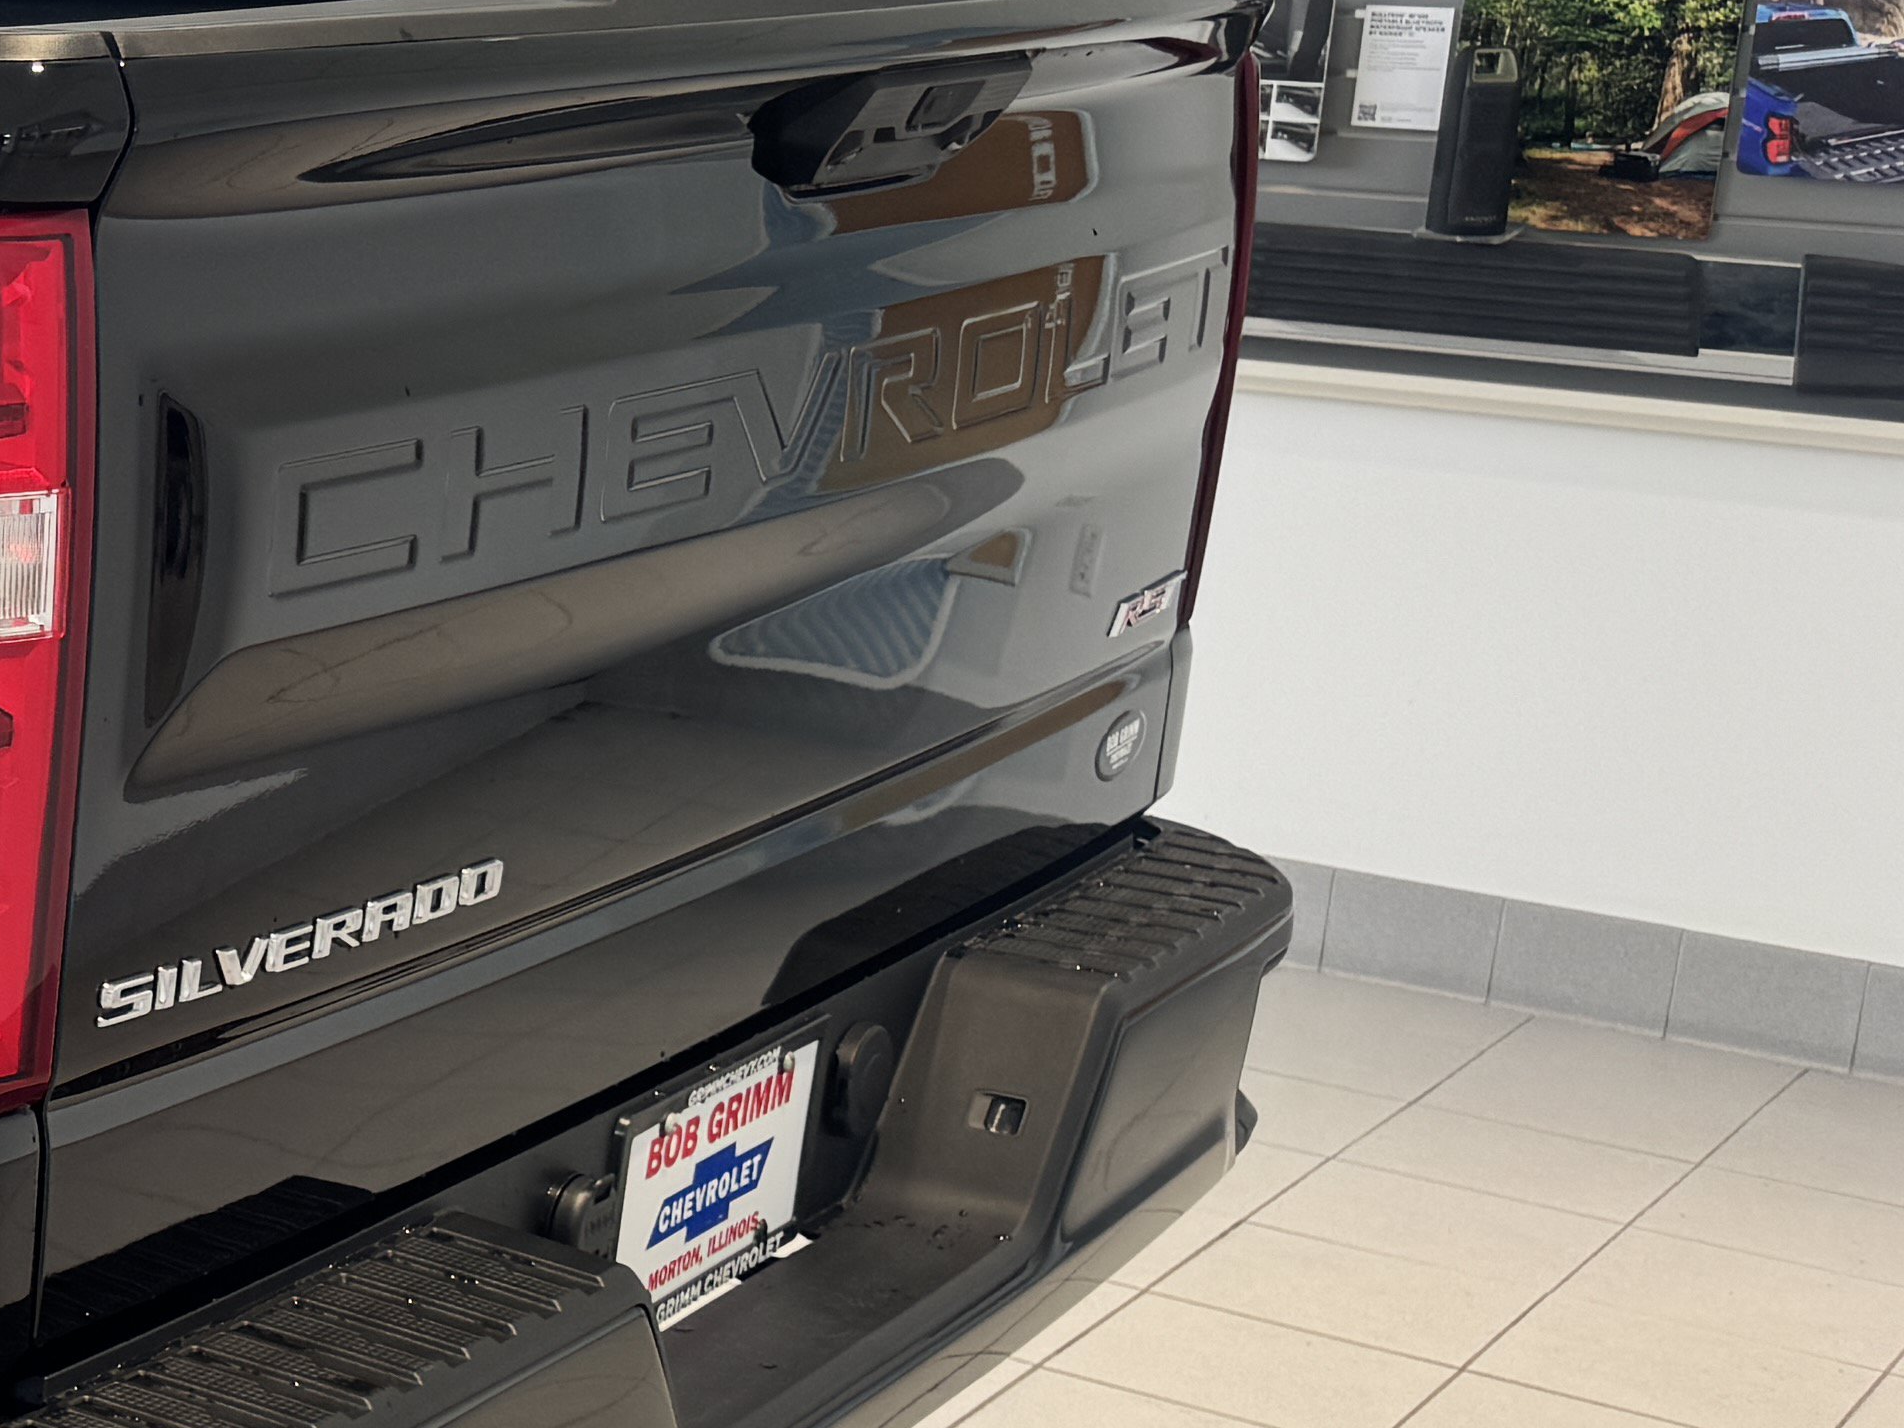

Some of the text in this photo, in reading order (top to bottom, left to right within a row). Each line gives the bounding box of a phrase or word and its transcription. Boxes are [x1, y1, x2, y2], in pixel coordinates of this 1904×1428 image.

[268, 245, 1229, 599] CHEVROLET
[96, 858, 505, 1028] SILVERADO
[645, 1068, 795, 1180] BOB GRIMM
[658, 1154, 762, 1234] CHEVROLET
[648, 1210, 760, 1291] MORTON, ILLINOIS
[656, 1231, 784, 1324] GRIMM CHEVROLET
